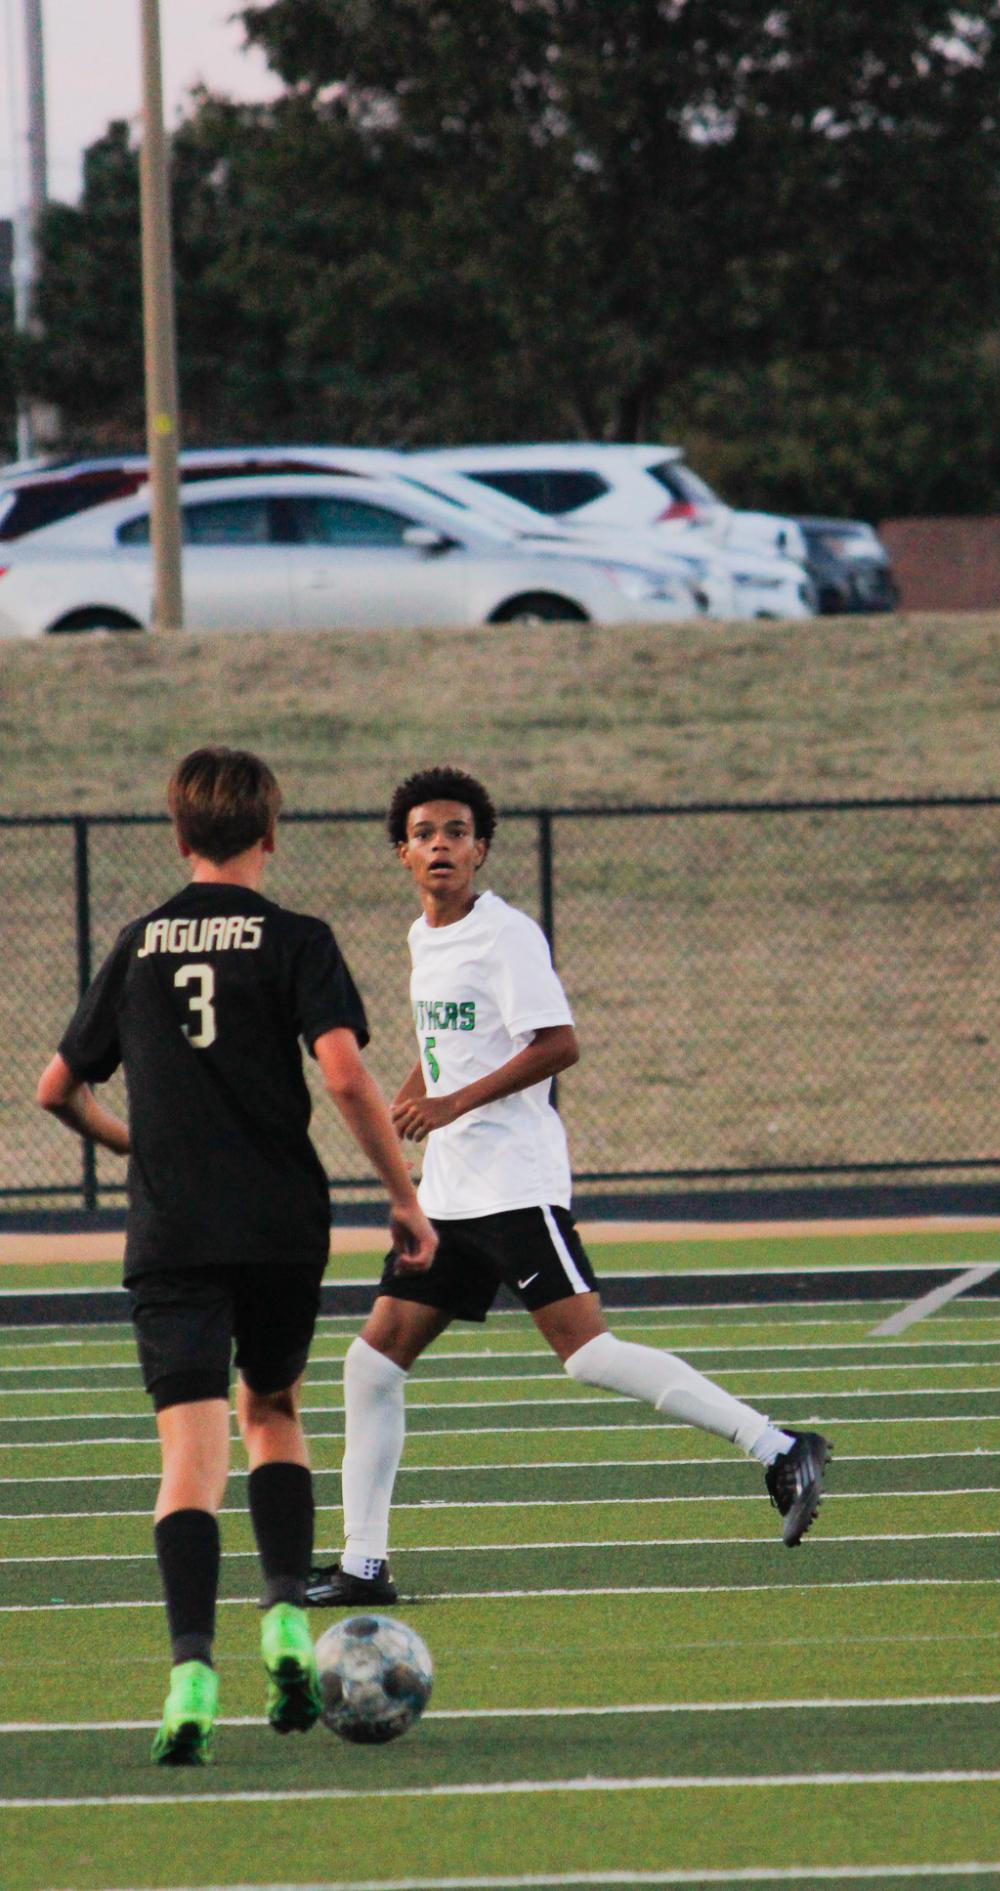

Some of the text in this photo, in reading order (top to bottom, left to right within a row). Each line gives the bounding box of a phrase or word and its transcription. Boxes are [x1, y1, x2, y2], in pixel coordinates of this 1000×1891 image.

[137, 916, 265, 958] JAGUARS
[174, 963, 217, 1049] 3
[415, 1000, 475, 1031] THERS
